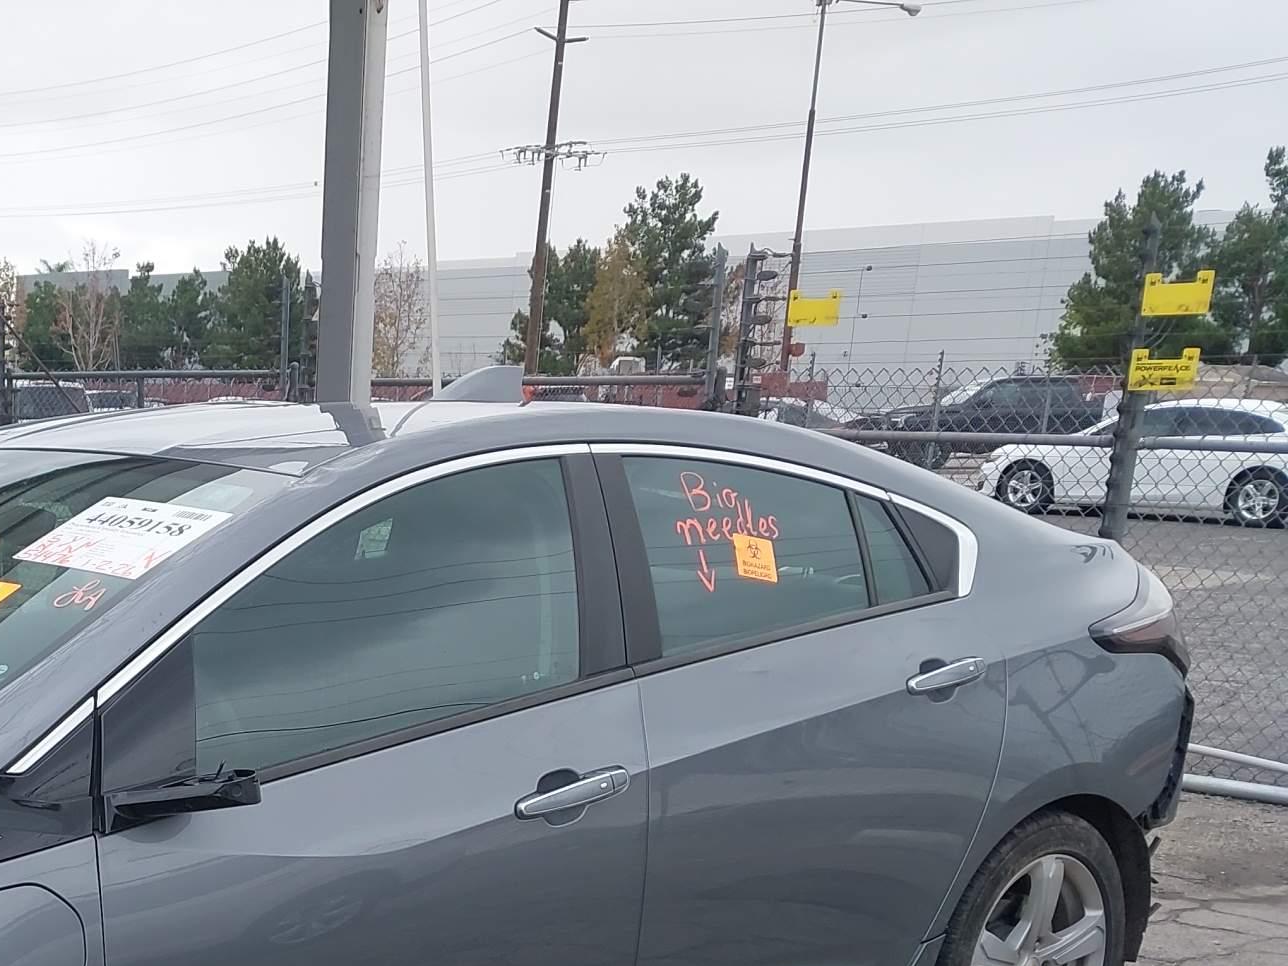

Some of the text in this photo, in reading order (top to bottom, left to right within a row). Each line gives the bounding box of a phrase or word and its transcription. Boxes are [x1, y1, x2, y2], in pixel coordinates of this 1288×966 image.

[680, 471, 738, 512] Bio
[85, 512, 192, 536] 44059158
[676, 497, 778, 545] needles
